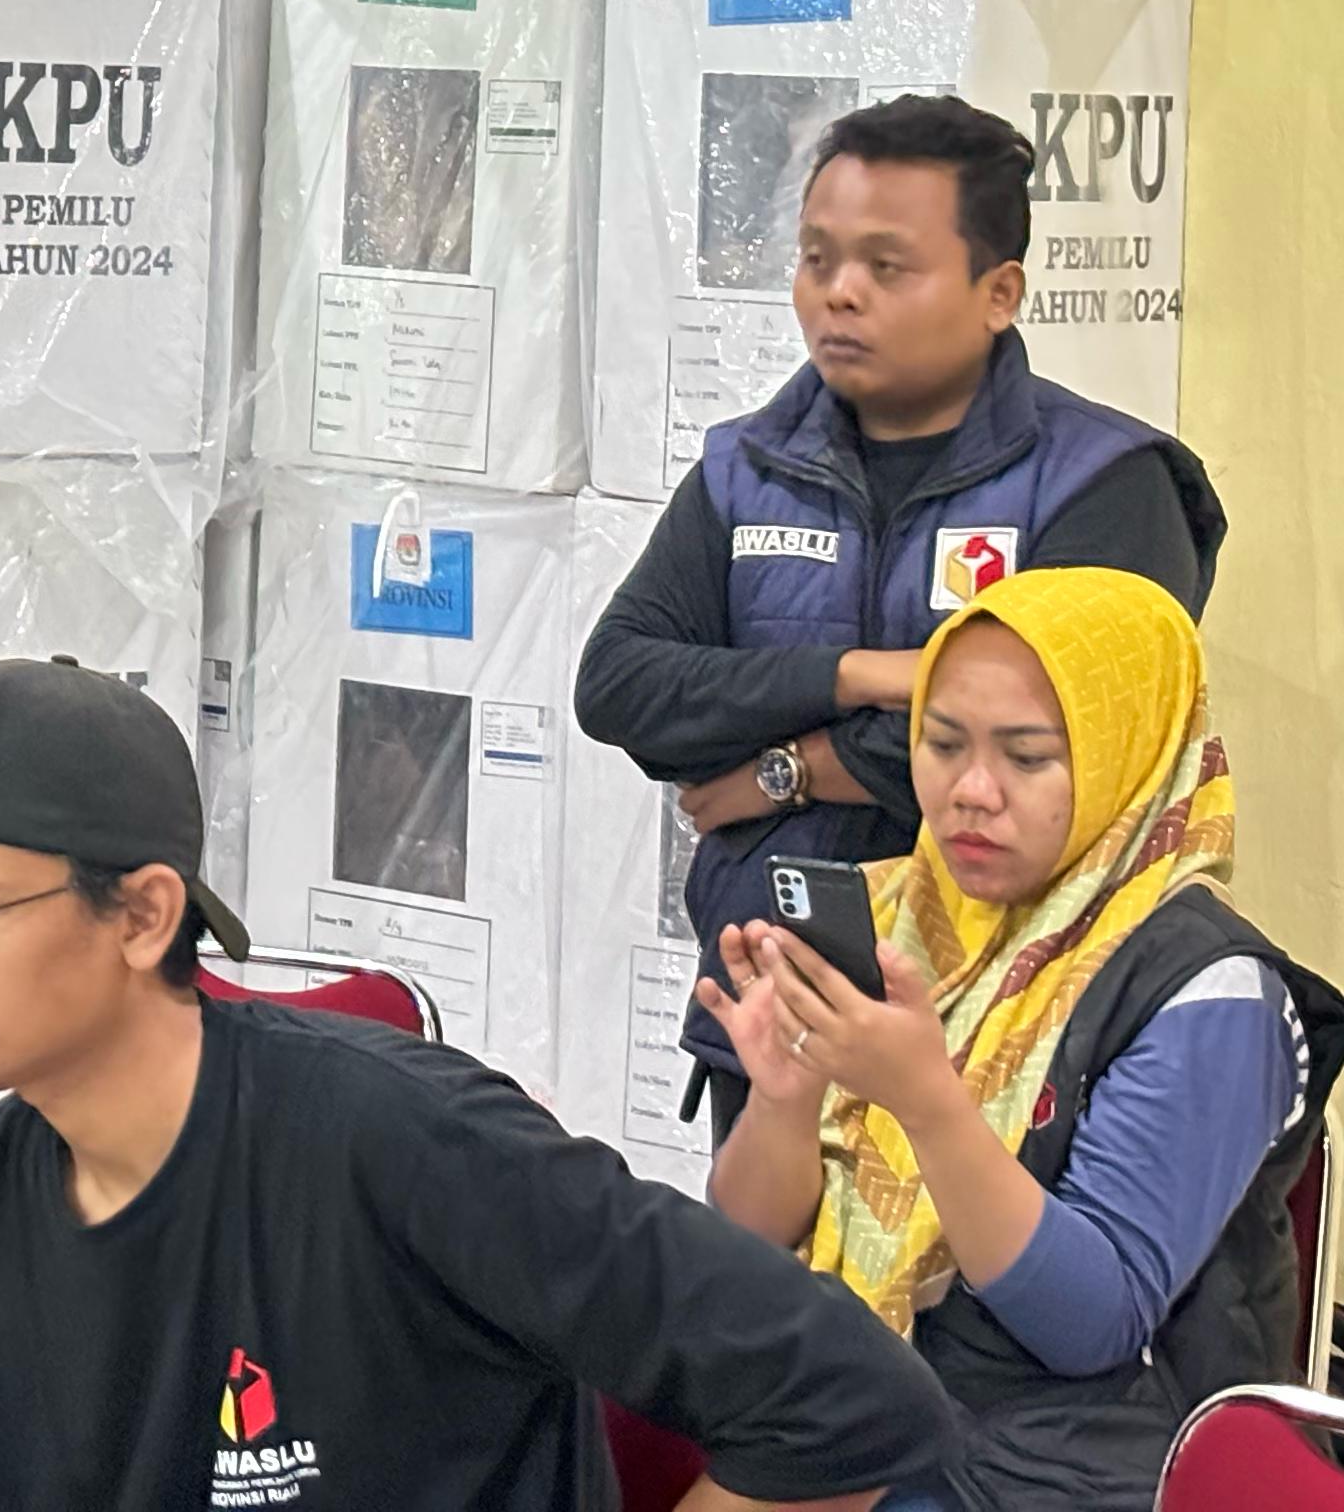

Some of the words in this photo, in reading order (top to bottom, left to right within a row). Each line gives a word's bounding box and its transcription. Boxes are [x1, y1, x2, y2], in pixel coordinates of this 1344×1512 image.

[1028, 93, 1174, 203] KPU
[1, 194, 135, 227] PEMILU
[89, 244, 174, 277] 2024
[1044, 236, 1152, 270] PEMILU
[1114, 288, 1183, 322] 2024
[214, 1440, 316, 1476] WASLU
[267, 1482, 302, 1503] RIAU
